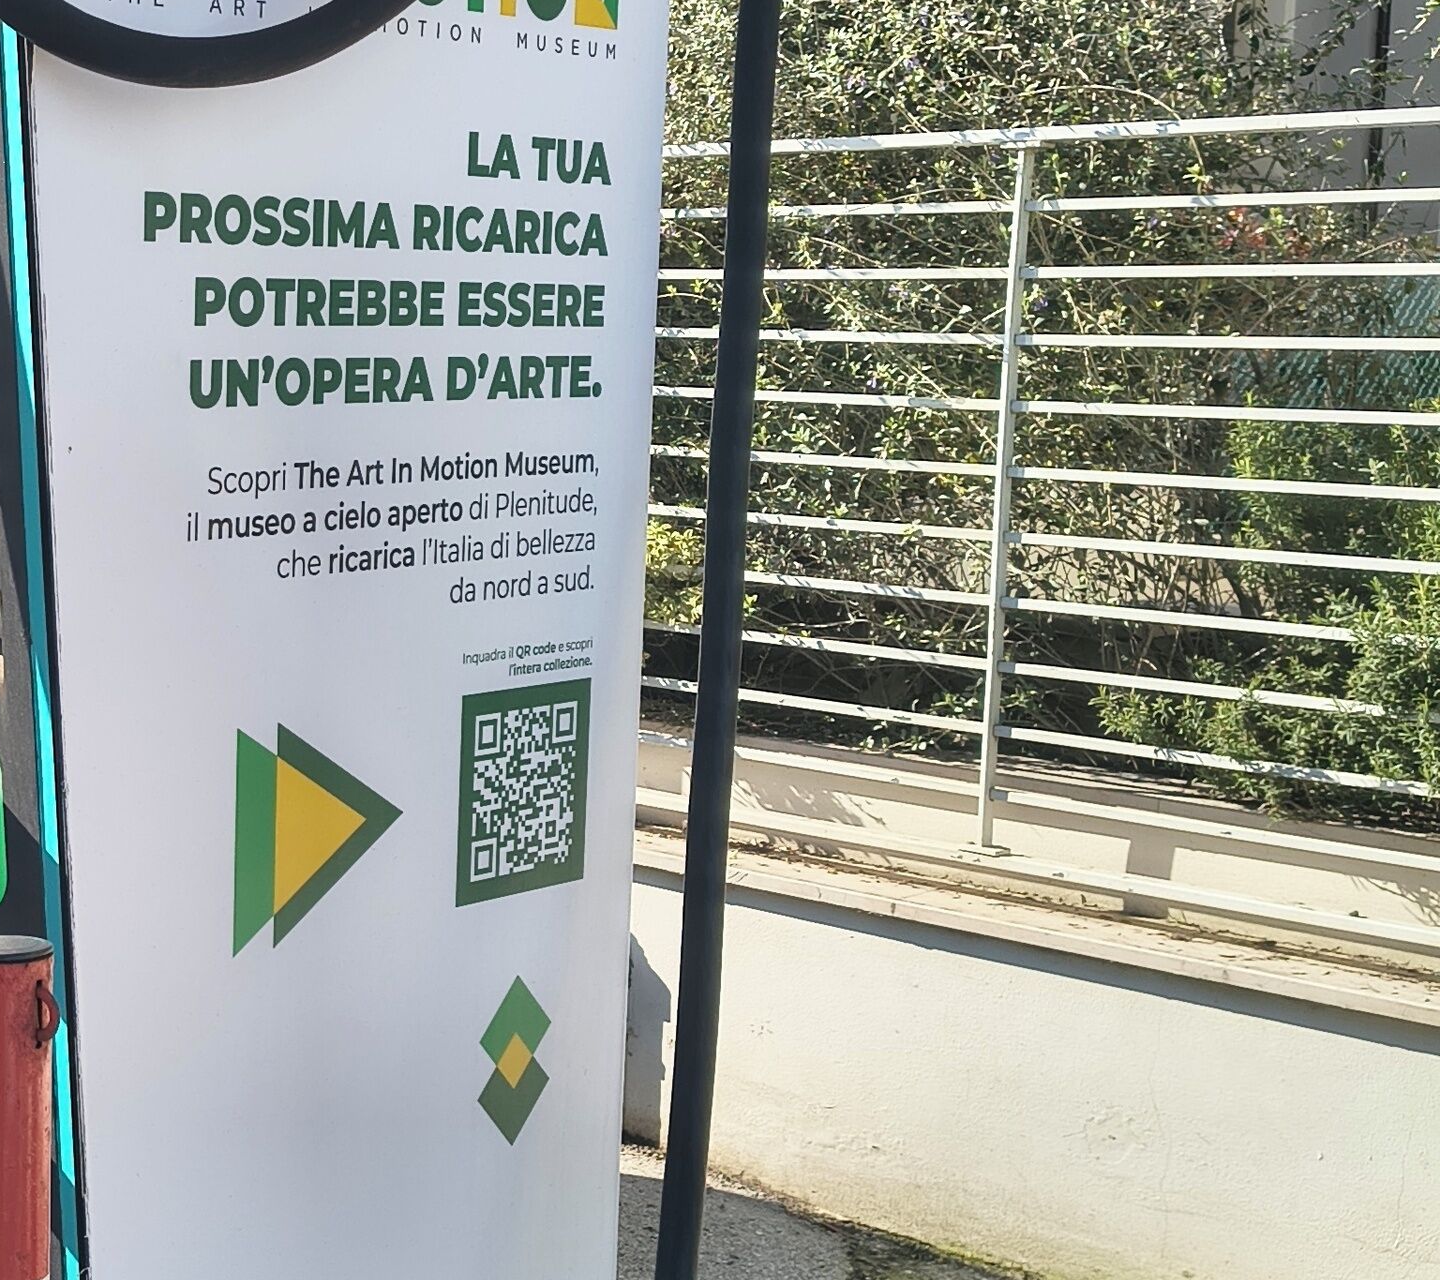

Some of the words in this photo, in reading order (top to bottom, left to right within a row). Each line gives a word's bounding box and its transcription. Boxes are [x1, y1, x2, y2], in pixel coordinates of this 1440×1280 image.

[516, 32, 617, 60] MUSEUM
[467, 131, 521, 179] LA
[531, 136, 612, 186] TUA
[143, 191, 400, 250] PROSSIMA
[412, 203, 609, 257] RICARICA
[194, 276, 445, 327] POTREBBE
[457, 281, 606, 328] ESSERE
[207, 462, 288, 499] Scopri
[294, 461, 340, 490] The
[346, 458, 384, 487] Art
[391, 457, 413, 483] In
[420, 452, 498, 482] Motion
[504, 449, 600, 479] Museum,
[186, 512, 200, 542] il
[207, 511, 296, 540] museo
[303, 513, 317, 533] a
[324, 500, 382, 532] cielo
[387, 497, 464, 531] aperto
[469, 491, 489, 520] di
[496, 486, 598, 519] Plenitude,
[276, 548, 322, 580] che
[328, 540, 416, 575] ricarica
[490, 531, 510, 560] di
[516, 527, 596, 557] bellezza
[450, 577, 477, 604] da
[482, 571, 531, 600] nord
[538, 576, 549, 595] a
[554, 564, 595, 593] sud.
[462, 648, 506, 665] Inquadra
[508, 646, 514, 658] il
[516, 645, 531, 659] QR
[532, 641, 557, 655] code
[558, 642, 564, 652] e
[565, 636, 594, 652] scopri
[543, 656, 593, 672] collezione.
